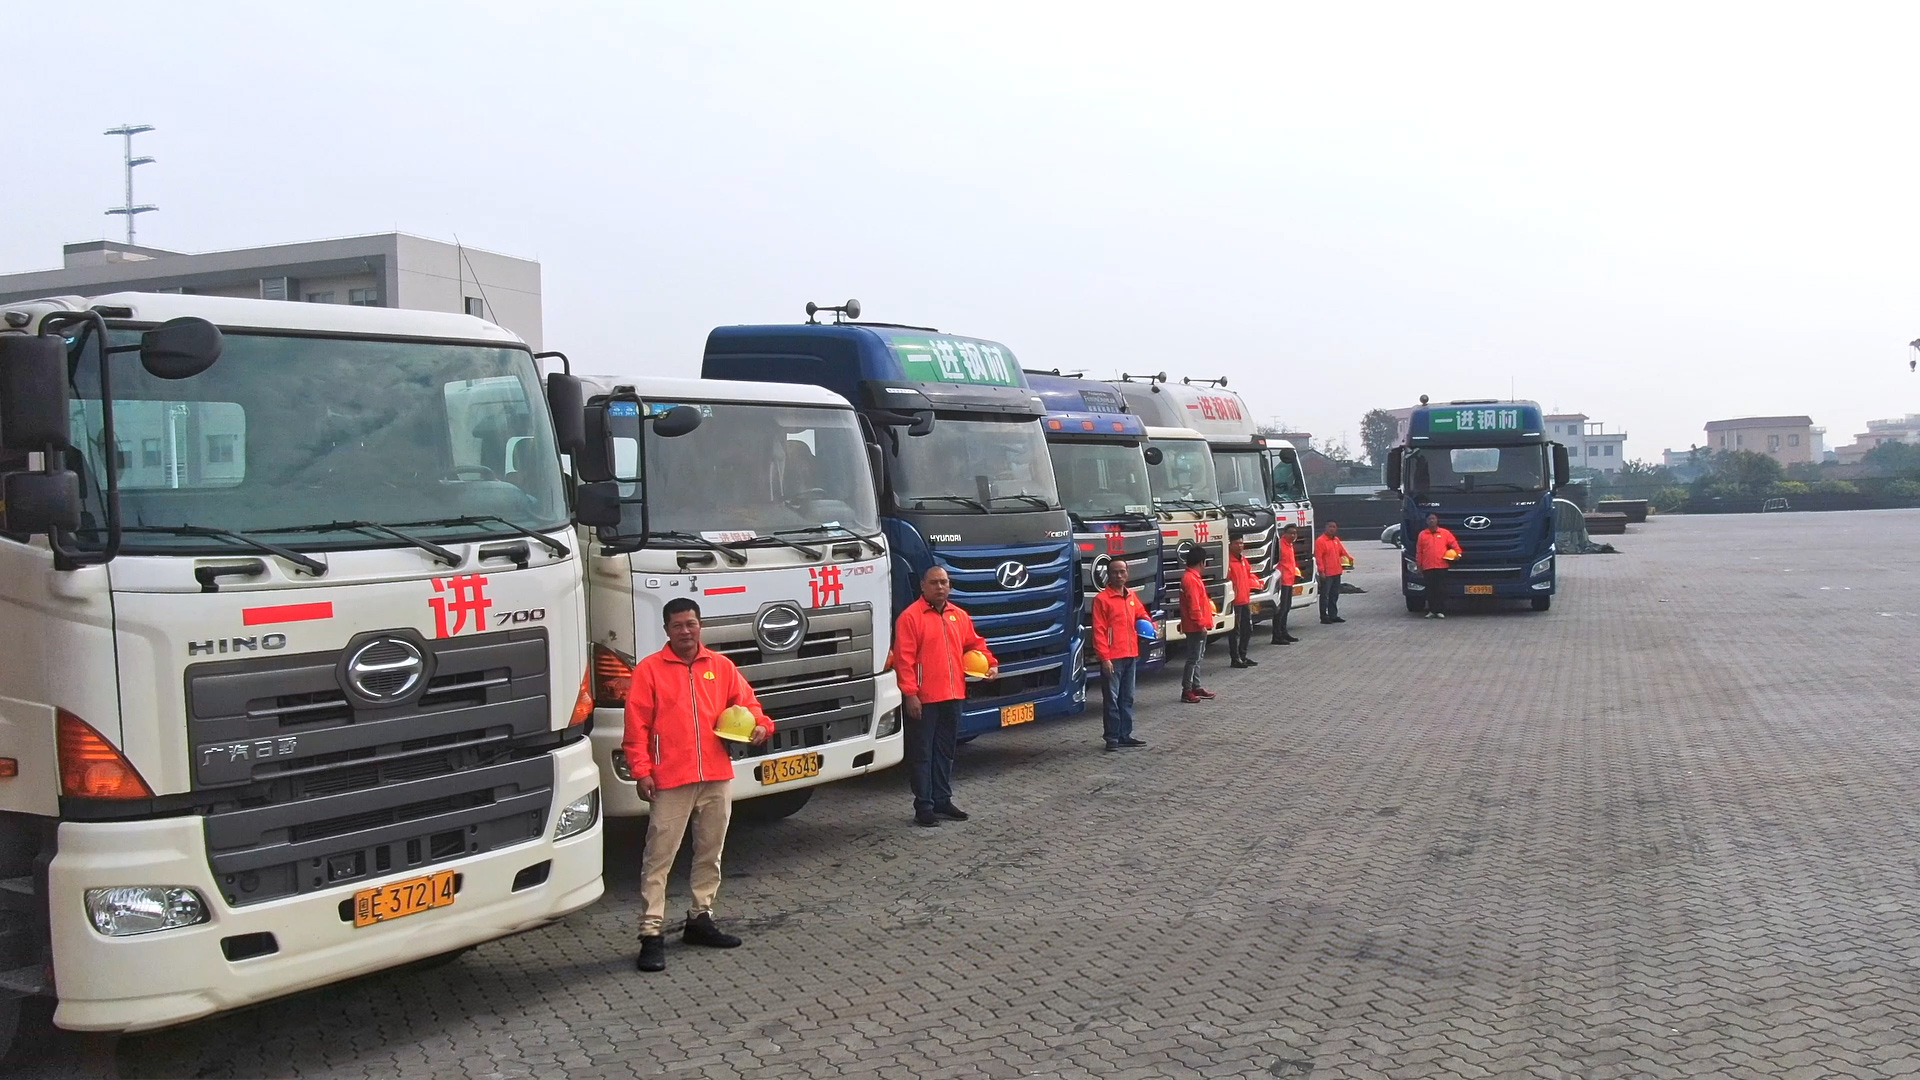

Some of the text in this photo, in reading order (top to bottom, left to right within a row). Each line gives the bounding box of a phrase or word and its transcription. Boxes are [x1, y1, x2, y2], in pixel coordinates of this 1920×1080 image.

[907, 340, 1010, 382] 一进钢材
[1186, 396, 1242, 420] 一进钢材
[1434, 410, 1517, 430] 一进钢材
[1233, 517, 1256, 528] JAC
[930, 534, 962, 542] HYUNDAI
[844, 565, 874, 577] 700
[493, 607, 545, 626] 700
[188, 632, 286, 656] HINO
